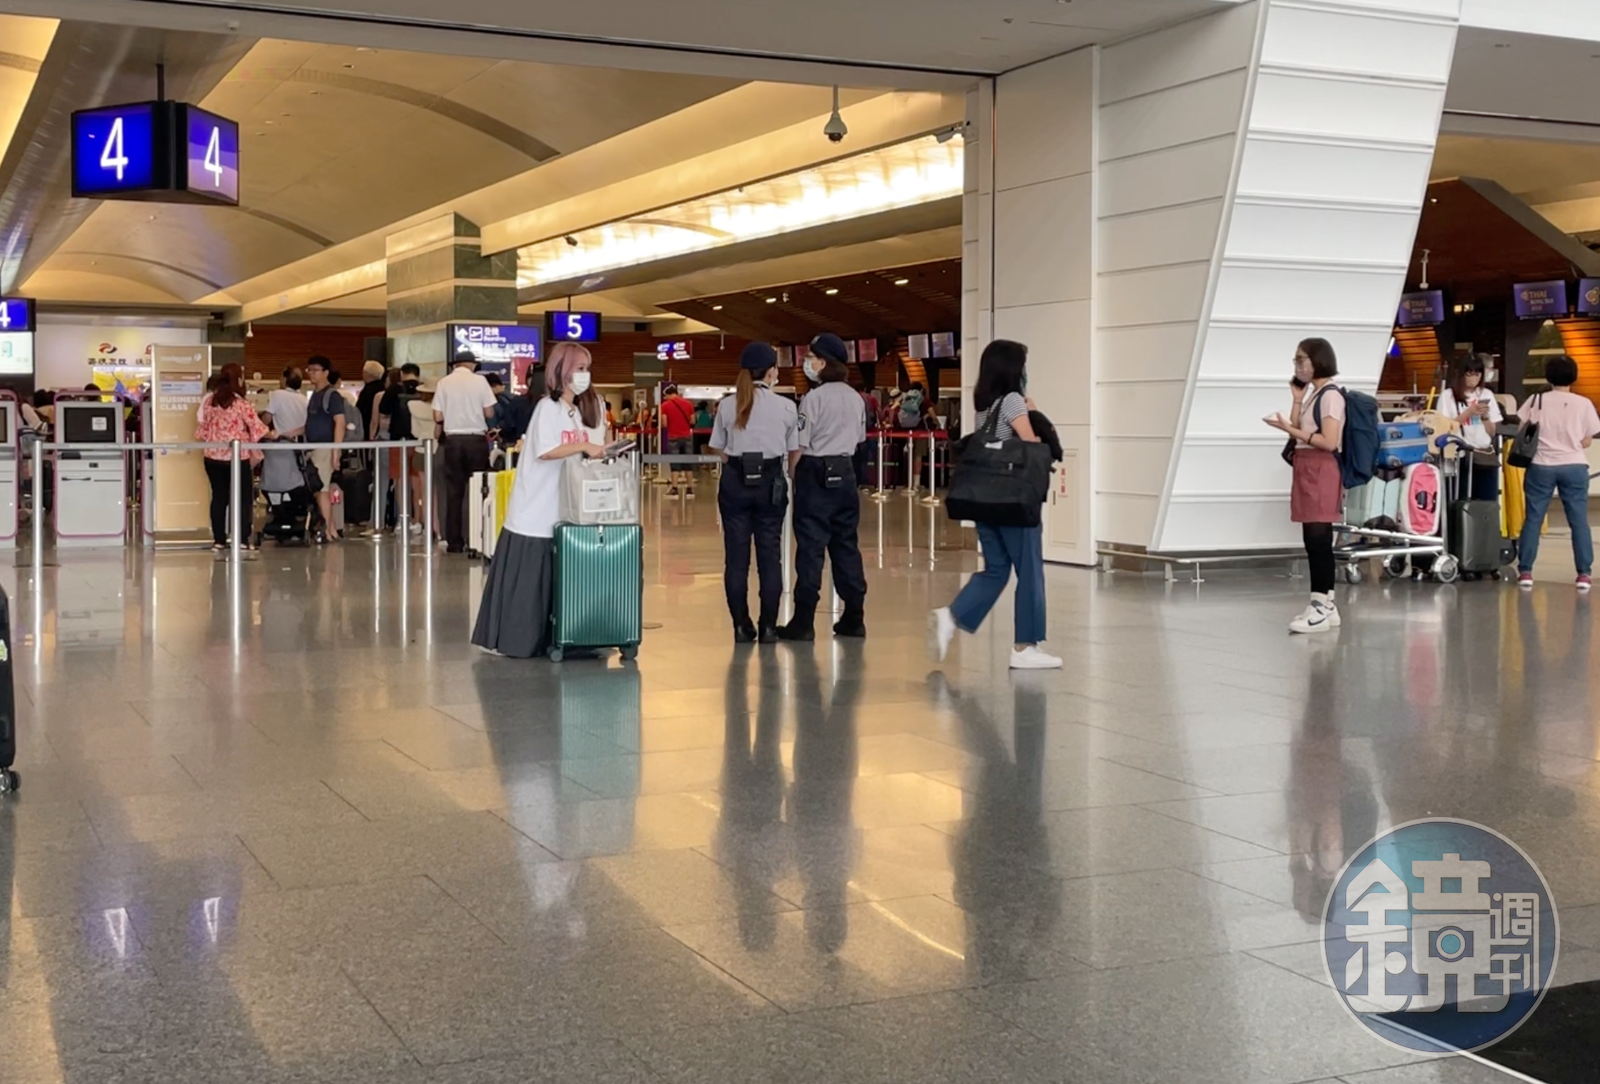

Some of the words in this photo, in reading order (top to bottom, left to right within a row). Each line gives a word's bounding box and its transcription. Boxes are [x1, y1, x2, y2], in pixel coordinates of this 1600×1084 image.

[100, 117, 129, 180] 4
[204, 126, 223, 187] 4
[0, 301, 11, 328] 4
[567, 314, 582, 338] 5
